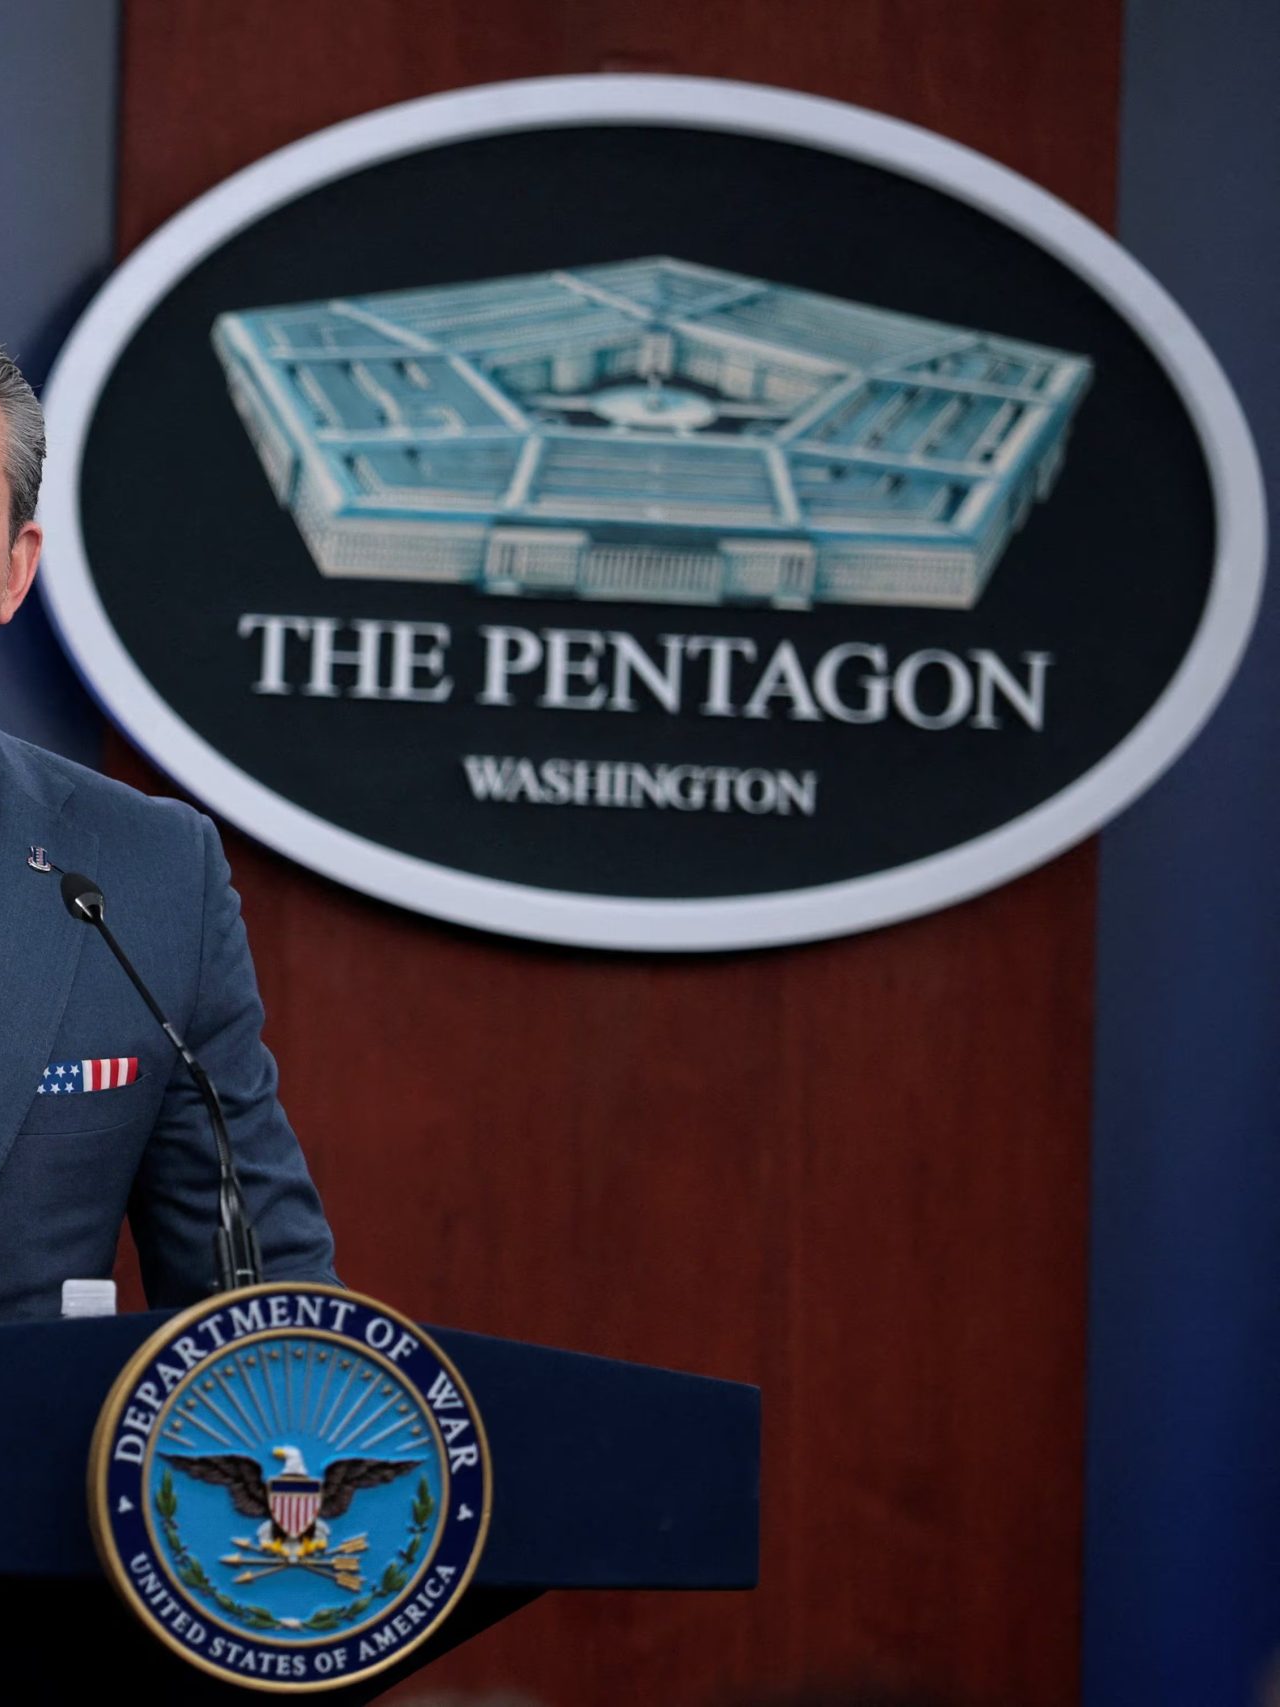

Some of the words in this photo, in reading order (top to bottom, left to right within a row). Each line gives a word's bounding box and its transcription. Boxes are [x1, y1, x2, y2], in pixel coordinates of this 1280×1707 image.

[238, 613, 453, 704] THE
[476, 625, 1053, 732] PENTAGON
[462, 755, 818, 817] WASHINGTON
[115, 1296, 356, 1465] DEPARTMENT
[365, 1317, 419, 1363] OF
[426, 1371, 479, 1475] WAR
[130, 1552, 208, 1645] UNITED
[208, 1637, 307, 1676] STATES
[315, 1648, 349, 1674] OF
[359, 1562, 456, 1662] AMERICA
